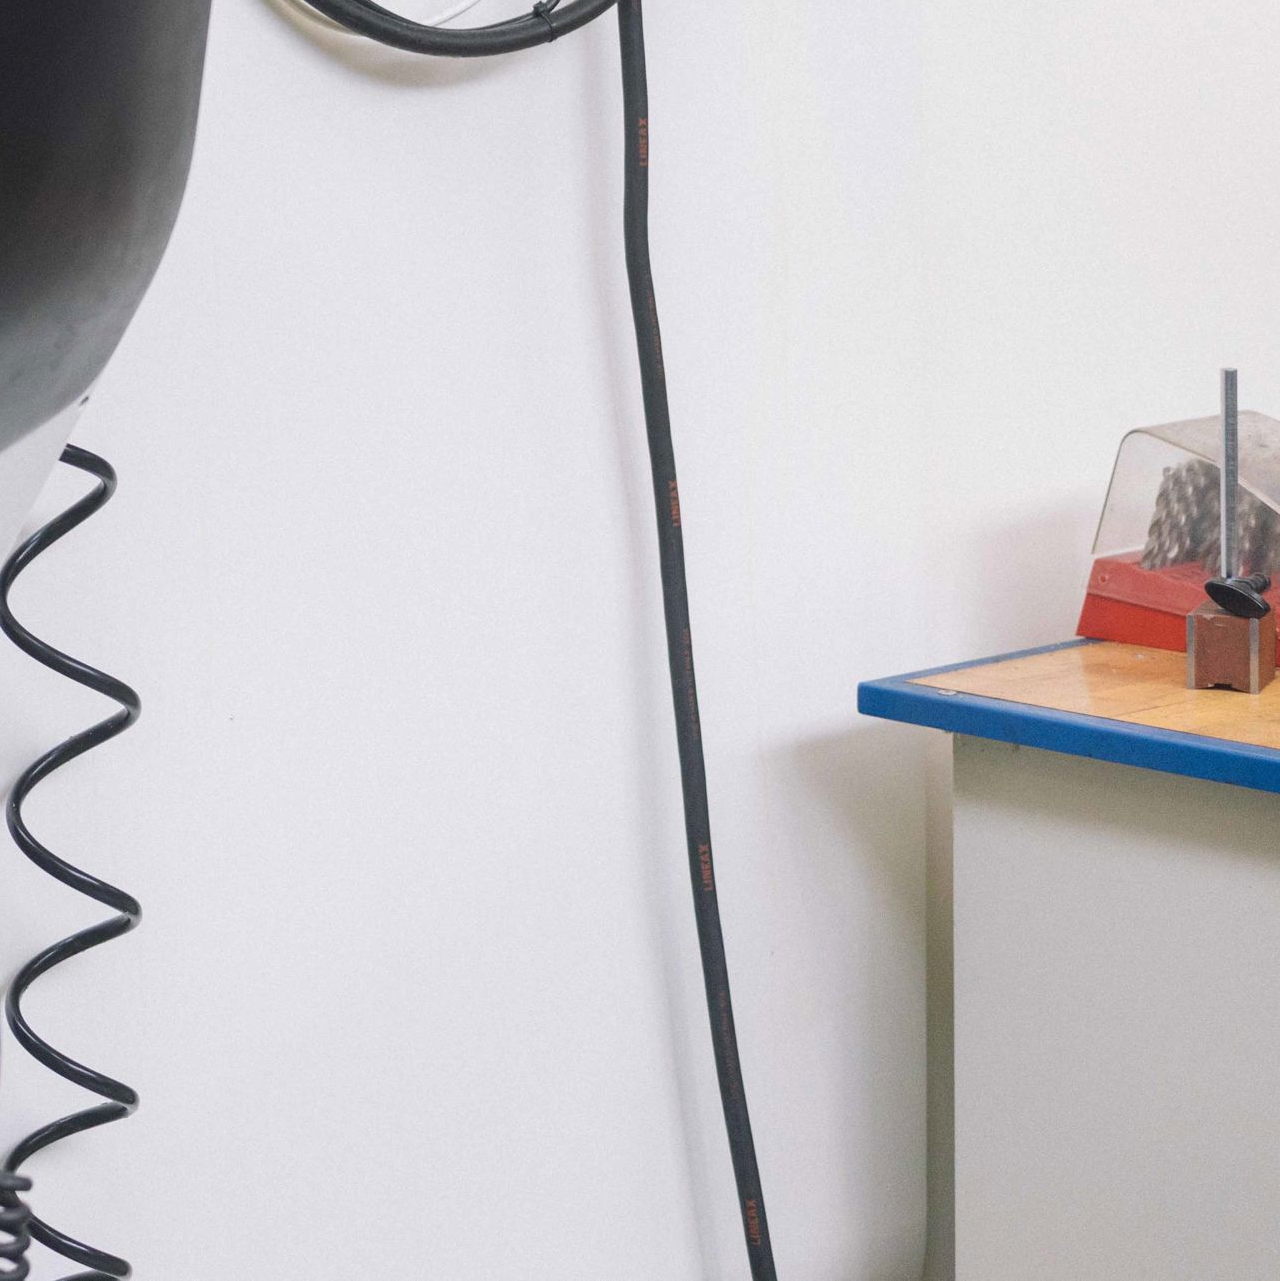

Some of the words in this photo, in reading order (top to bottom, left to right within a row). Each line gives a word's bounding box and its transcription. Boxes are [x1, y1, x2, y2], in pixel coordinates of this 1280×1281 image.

[638, 117, 648, 167] LINEAX
[668, 480, 681, 528] LINEAX
[698, 842, 713, 892] LINEAX
[746, 1199, 762, 1247] LINEAX
